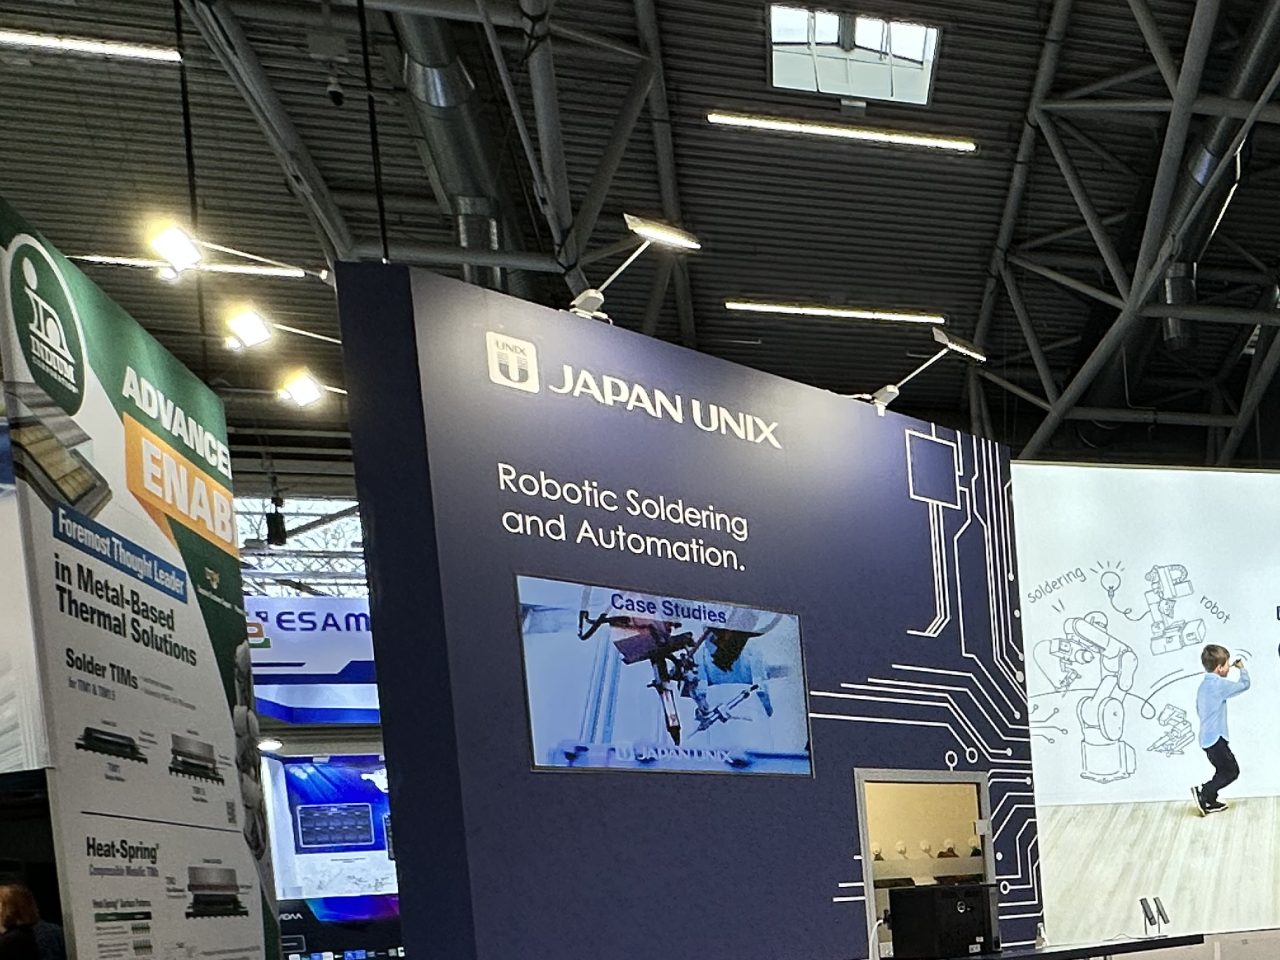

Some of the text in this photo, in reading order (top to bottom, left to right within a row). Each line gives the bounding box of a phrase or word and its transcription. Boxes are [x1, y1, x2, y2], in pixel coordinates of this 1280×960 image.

[496, 340, 527, 357] UNIX
[122, 366, 232, 479] ADVANCE
[549, 364, 782, 449] JAPAN UNIX
[497, 462, 749, 542] Robotic Soldering
[502, 510, 746, 572] and Automation.
[58, 507, 186, 595] Foremost Thought Leader
[54, 553, 72, 585] in
[77, 563, 175, 631] Metal-Based
[55, 584, 198, 667] Thermal Solutions
[611, 593, 727, 624] Case Studies
[1200, 594, 1231, 624] robot
[65, 648, 107, 678] Solder
[109, 663, 138, 689] TIMs
